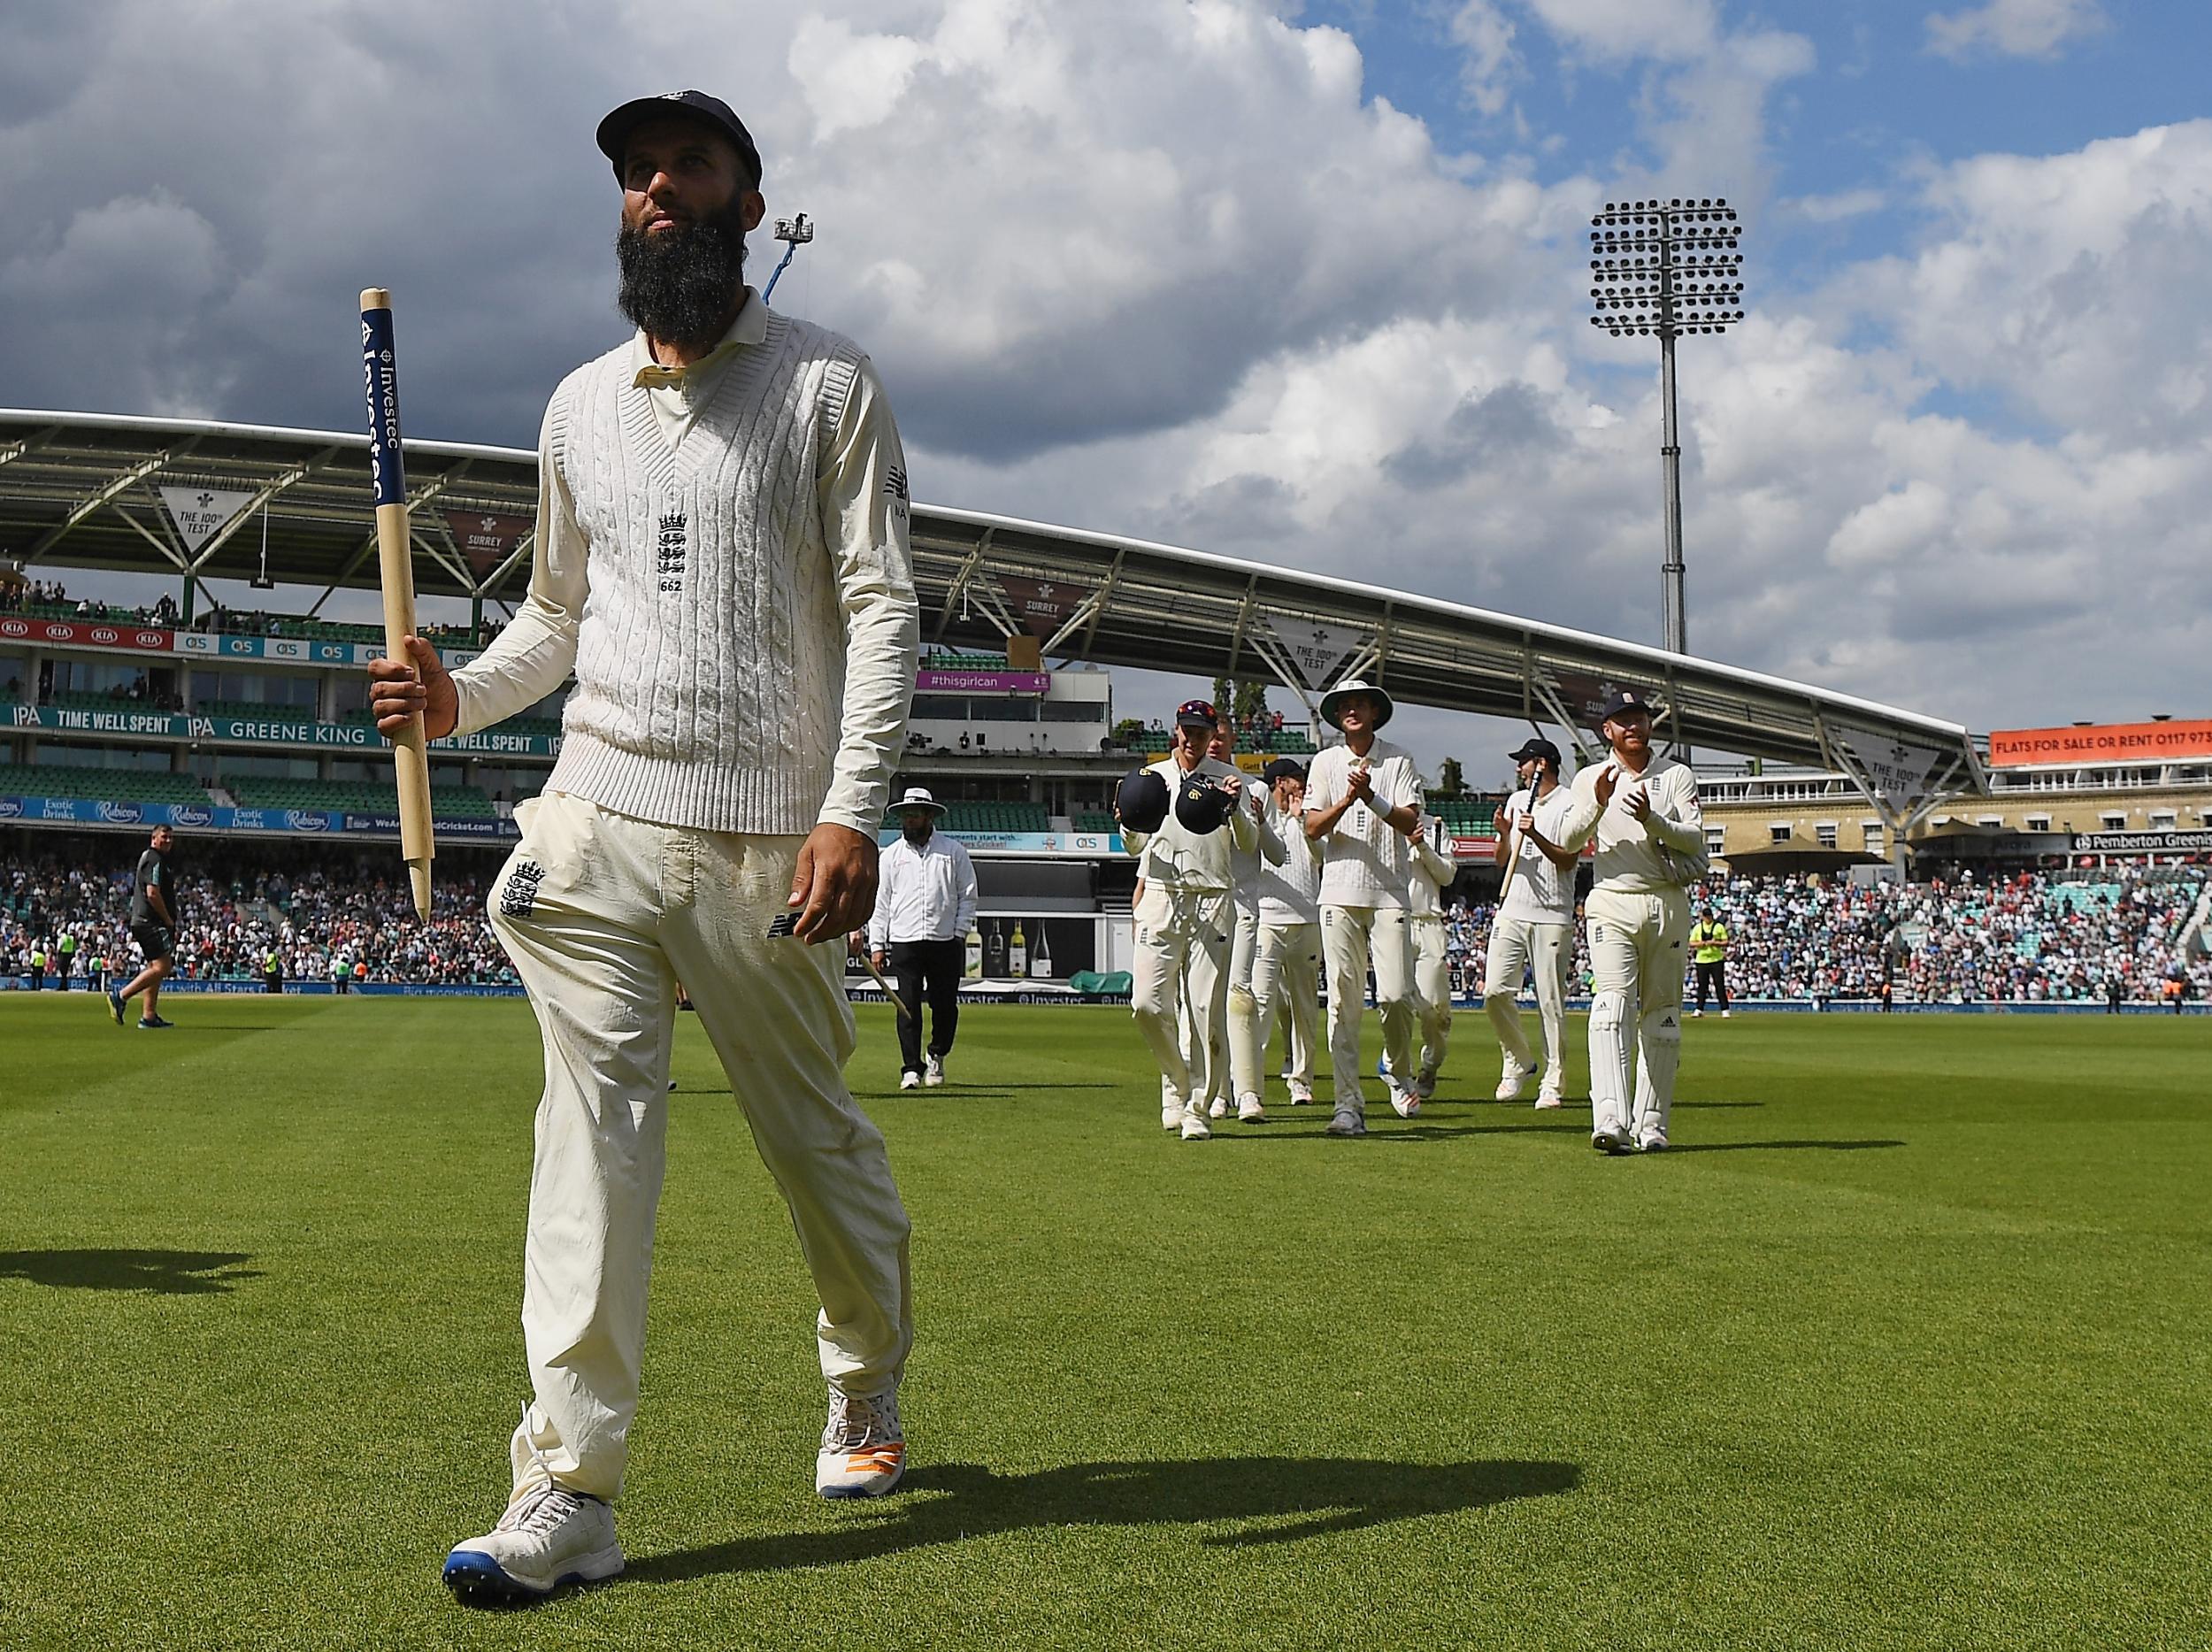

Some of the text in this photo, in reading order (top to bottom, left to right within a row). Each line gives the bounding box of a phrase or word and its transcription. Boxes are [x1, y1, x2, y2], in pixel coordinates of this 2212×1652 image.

[380, 367, 398, 449] Investec
[180, 511, 197, 522] THE
[188, 523, 211, 534] TEST
[467, 534, 502, 547] SURREY
[660, 580, 682, 592] 662
[1026, 600, 1060, 613] SURREY
[4, 622, 160, 645] KIA KIA KIA KIA
[1296, 646, 1314, 657] THE
[1304, 658, 1325, 670] TEST
[931, 675, 998, 688] #thisgirlcan
[13, 707, 42, 726] IPA
[58, 711, 171, 734] TIME WELL SPENT
[187, 718, 216, 737] IPA
[230, 722, 308, 741] GREENE
[316, 726, 365, 744] KING
[457, 735, 488, 750] WELL
[493, 737, 532, 752] SPENT
[1996, 741, 2032, 753] FLATS
[2035, 740, 2060, 751] FOR
[2064, 737, 2093, 749] SALE
[2098, 736, 2116, 748] OR
[2120, 734, 2153, 747] RENT
[1873, 763, 1892, 776] THE
[1882, 778, 1906, 791] TEST
[45, 798, 74, 810] Exotic
[42, 810, 75, 820] Drinks
[99, 801, 140, 822] Rubicon
[171, 804, 209, 824] Rubicon
[234, 809, 264, 819] Exotic
[232, 818, 265, 829] Drinks
[287, 809, 326, 829] Rubicon
[2093, 835, 2162, 849] Pemberton
[1031, 994, 1086, 1005] Investec
